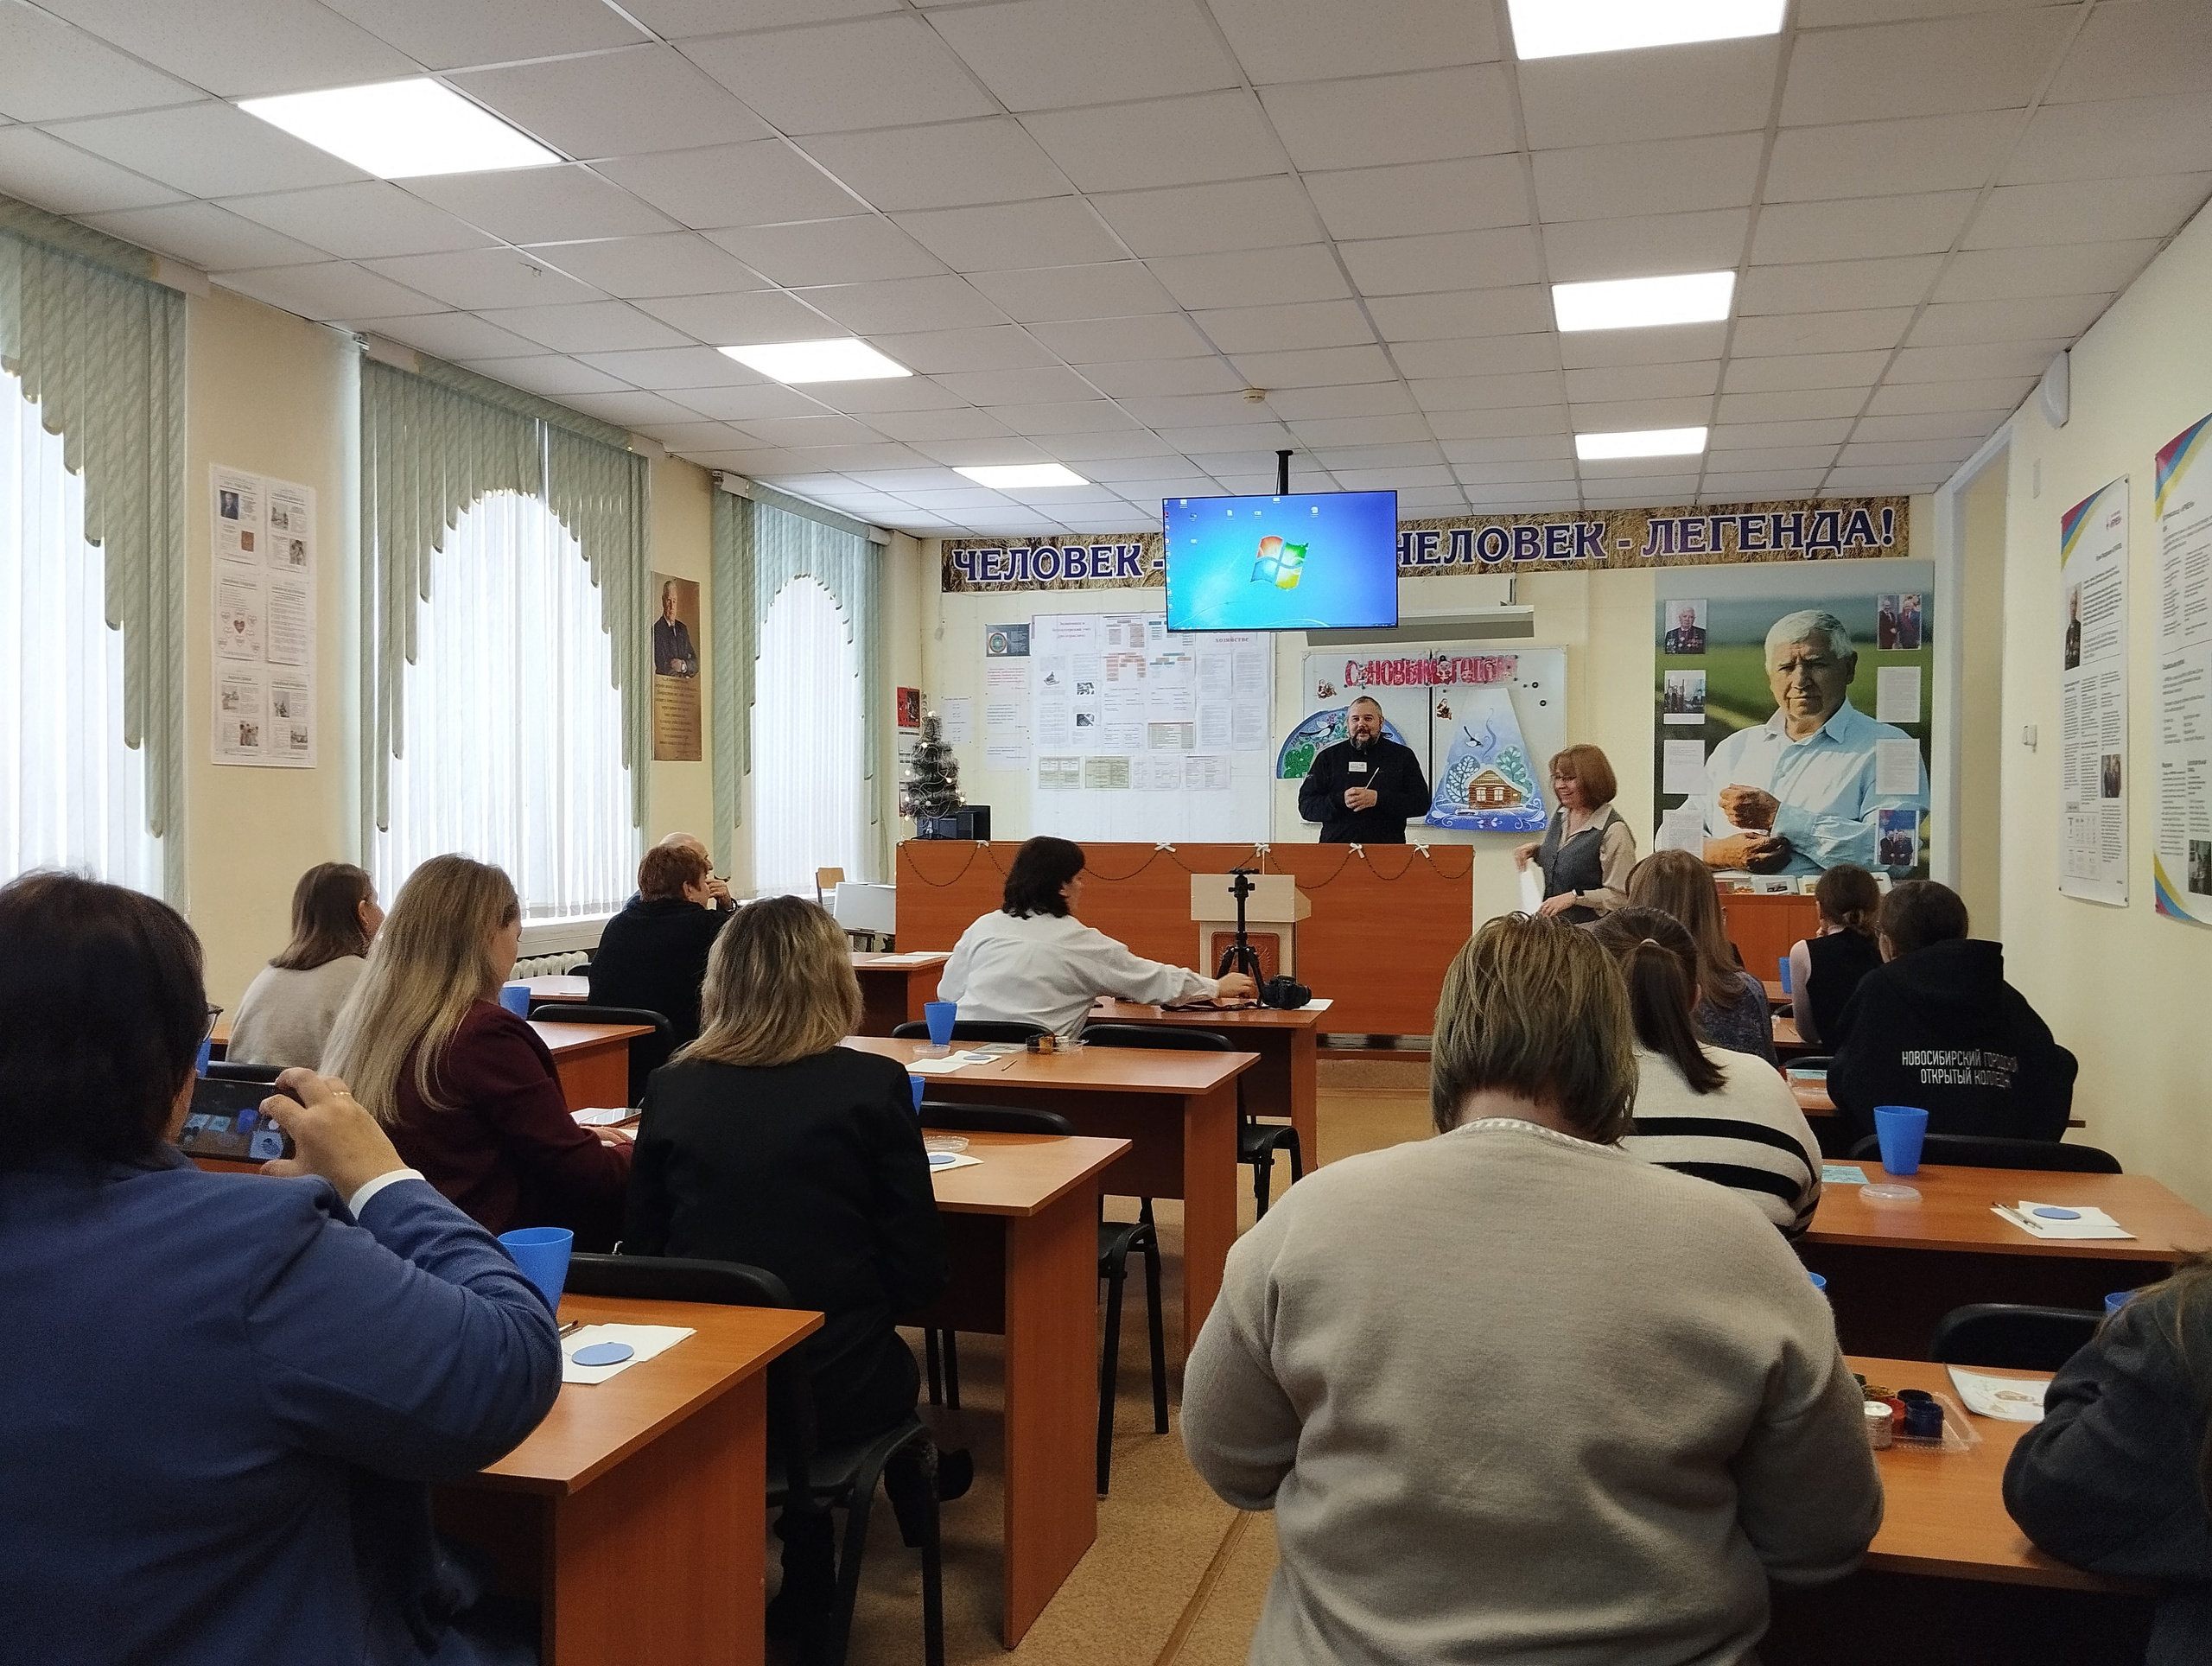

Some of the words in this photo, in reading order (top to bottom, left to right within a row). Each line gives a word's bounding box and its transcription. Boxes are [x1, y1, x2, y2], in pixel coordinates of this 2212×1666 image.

[952, 544, 1143, 582] ЧЕЛОВЕК
[1618, 537, 1635, 550] -
[1642, 506, 1896, 558] ЛЕГЕНДА!
[1344, 660, 1359, 687] С
[1367, 658, 1438, 686] НОВЫМ
[1902, 1049, 1981, 1066] НОВОСИБИРСКИЙ
[1921, 1067, 1972, 1084] ОТКРЫТЫЙ
